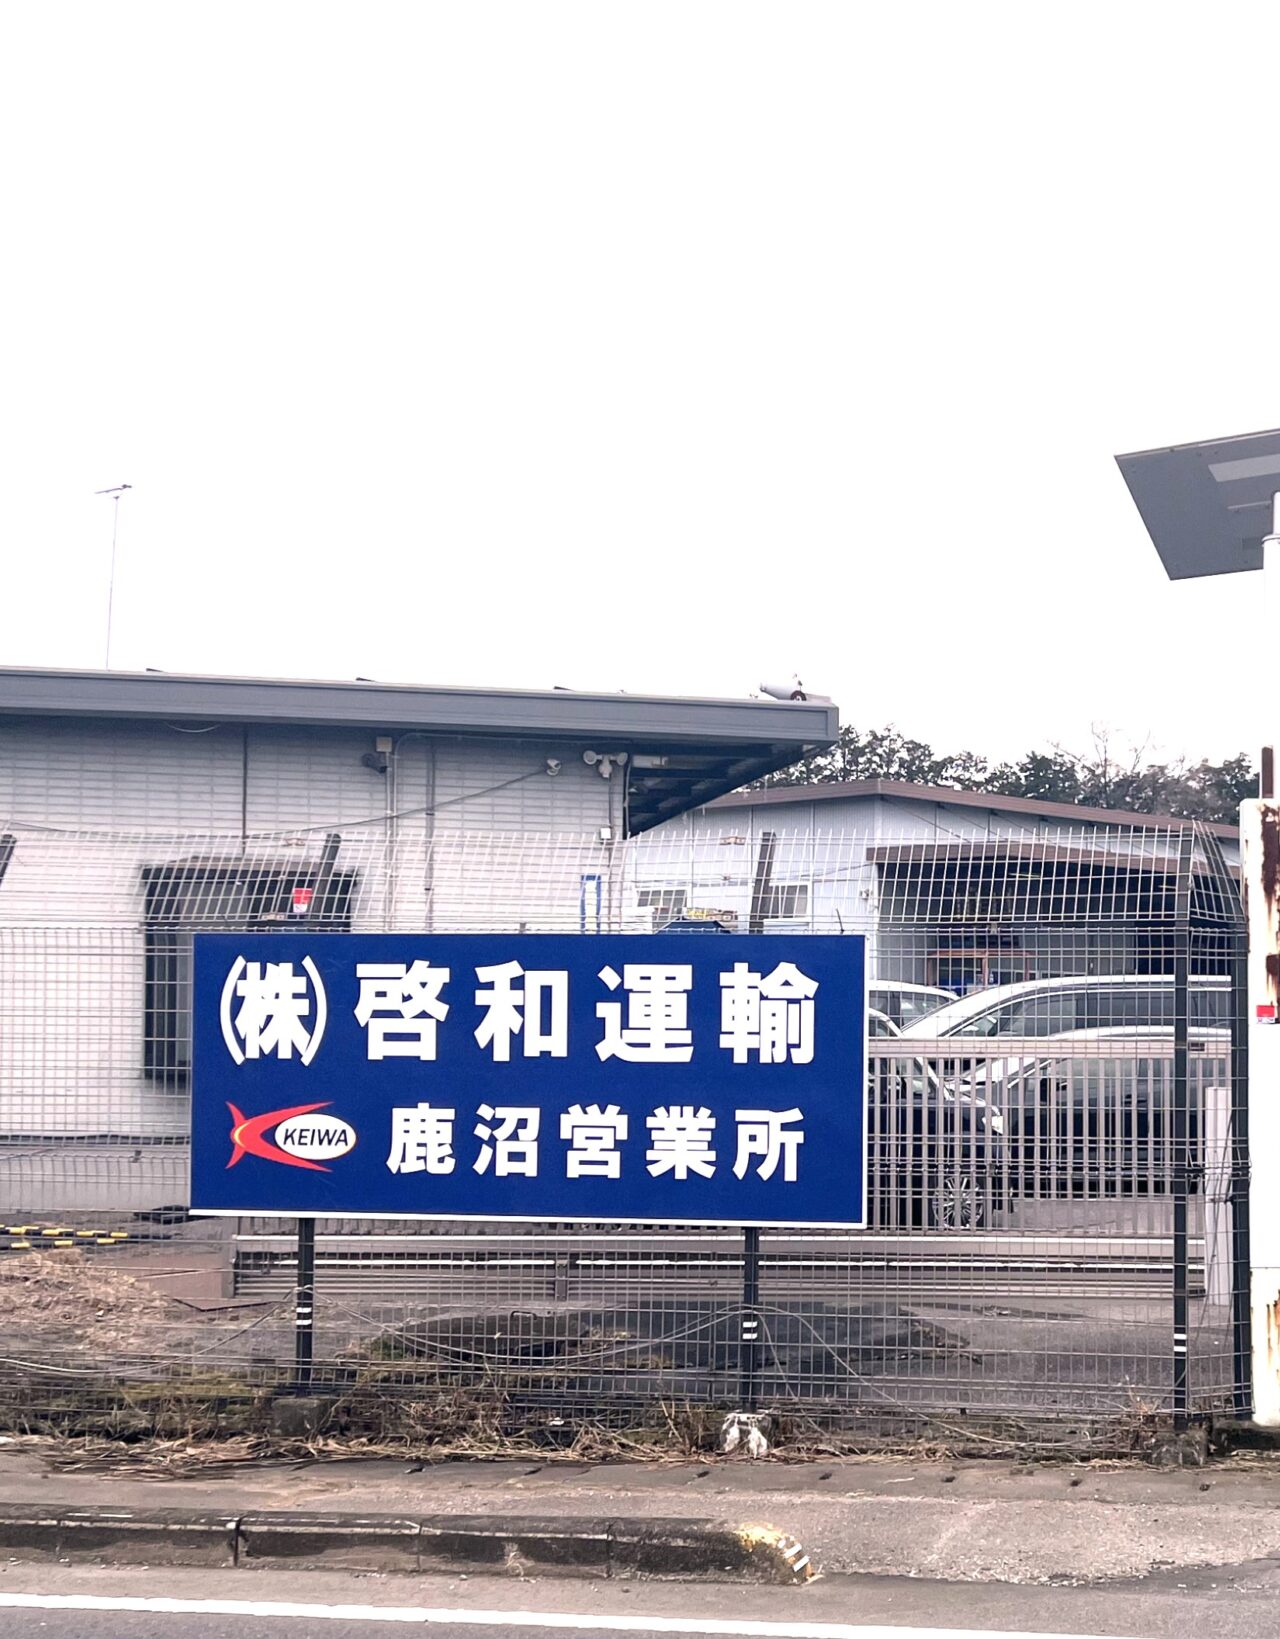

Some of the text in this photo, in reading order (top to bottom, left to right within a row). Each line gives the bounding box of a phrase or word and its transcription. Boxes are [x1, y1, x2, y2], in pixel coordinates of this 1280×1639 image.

[220, 955, 819, 1066] (株)啓和運輸
[283, 1128, 348, 1146] KEIWA
[387, 1102, 804, 1182] 鹿沼営業所
